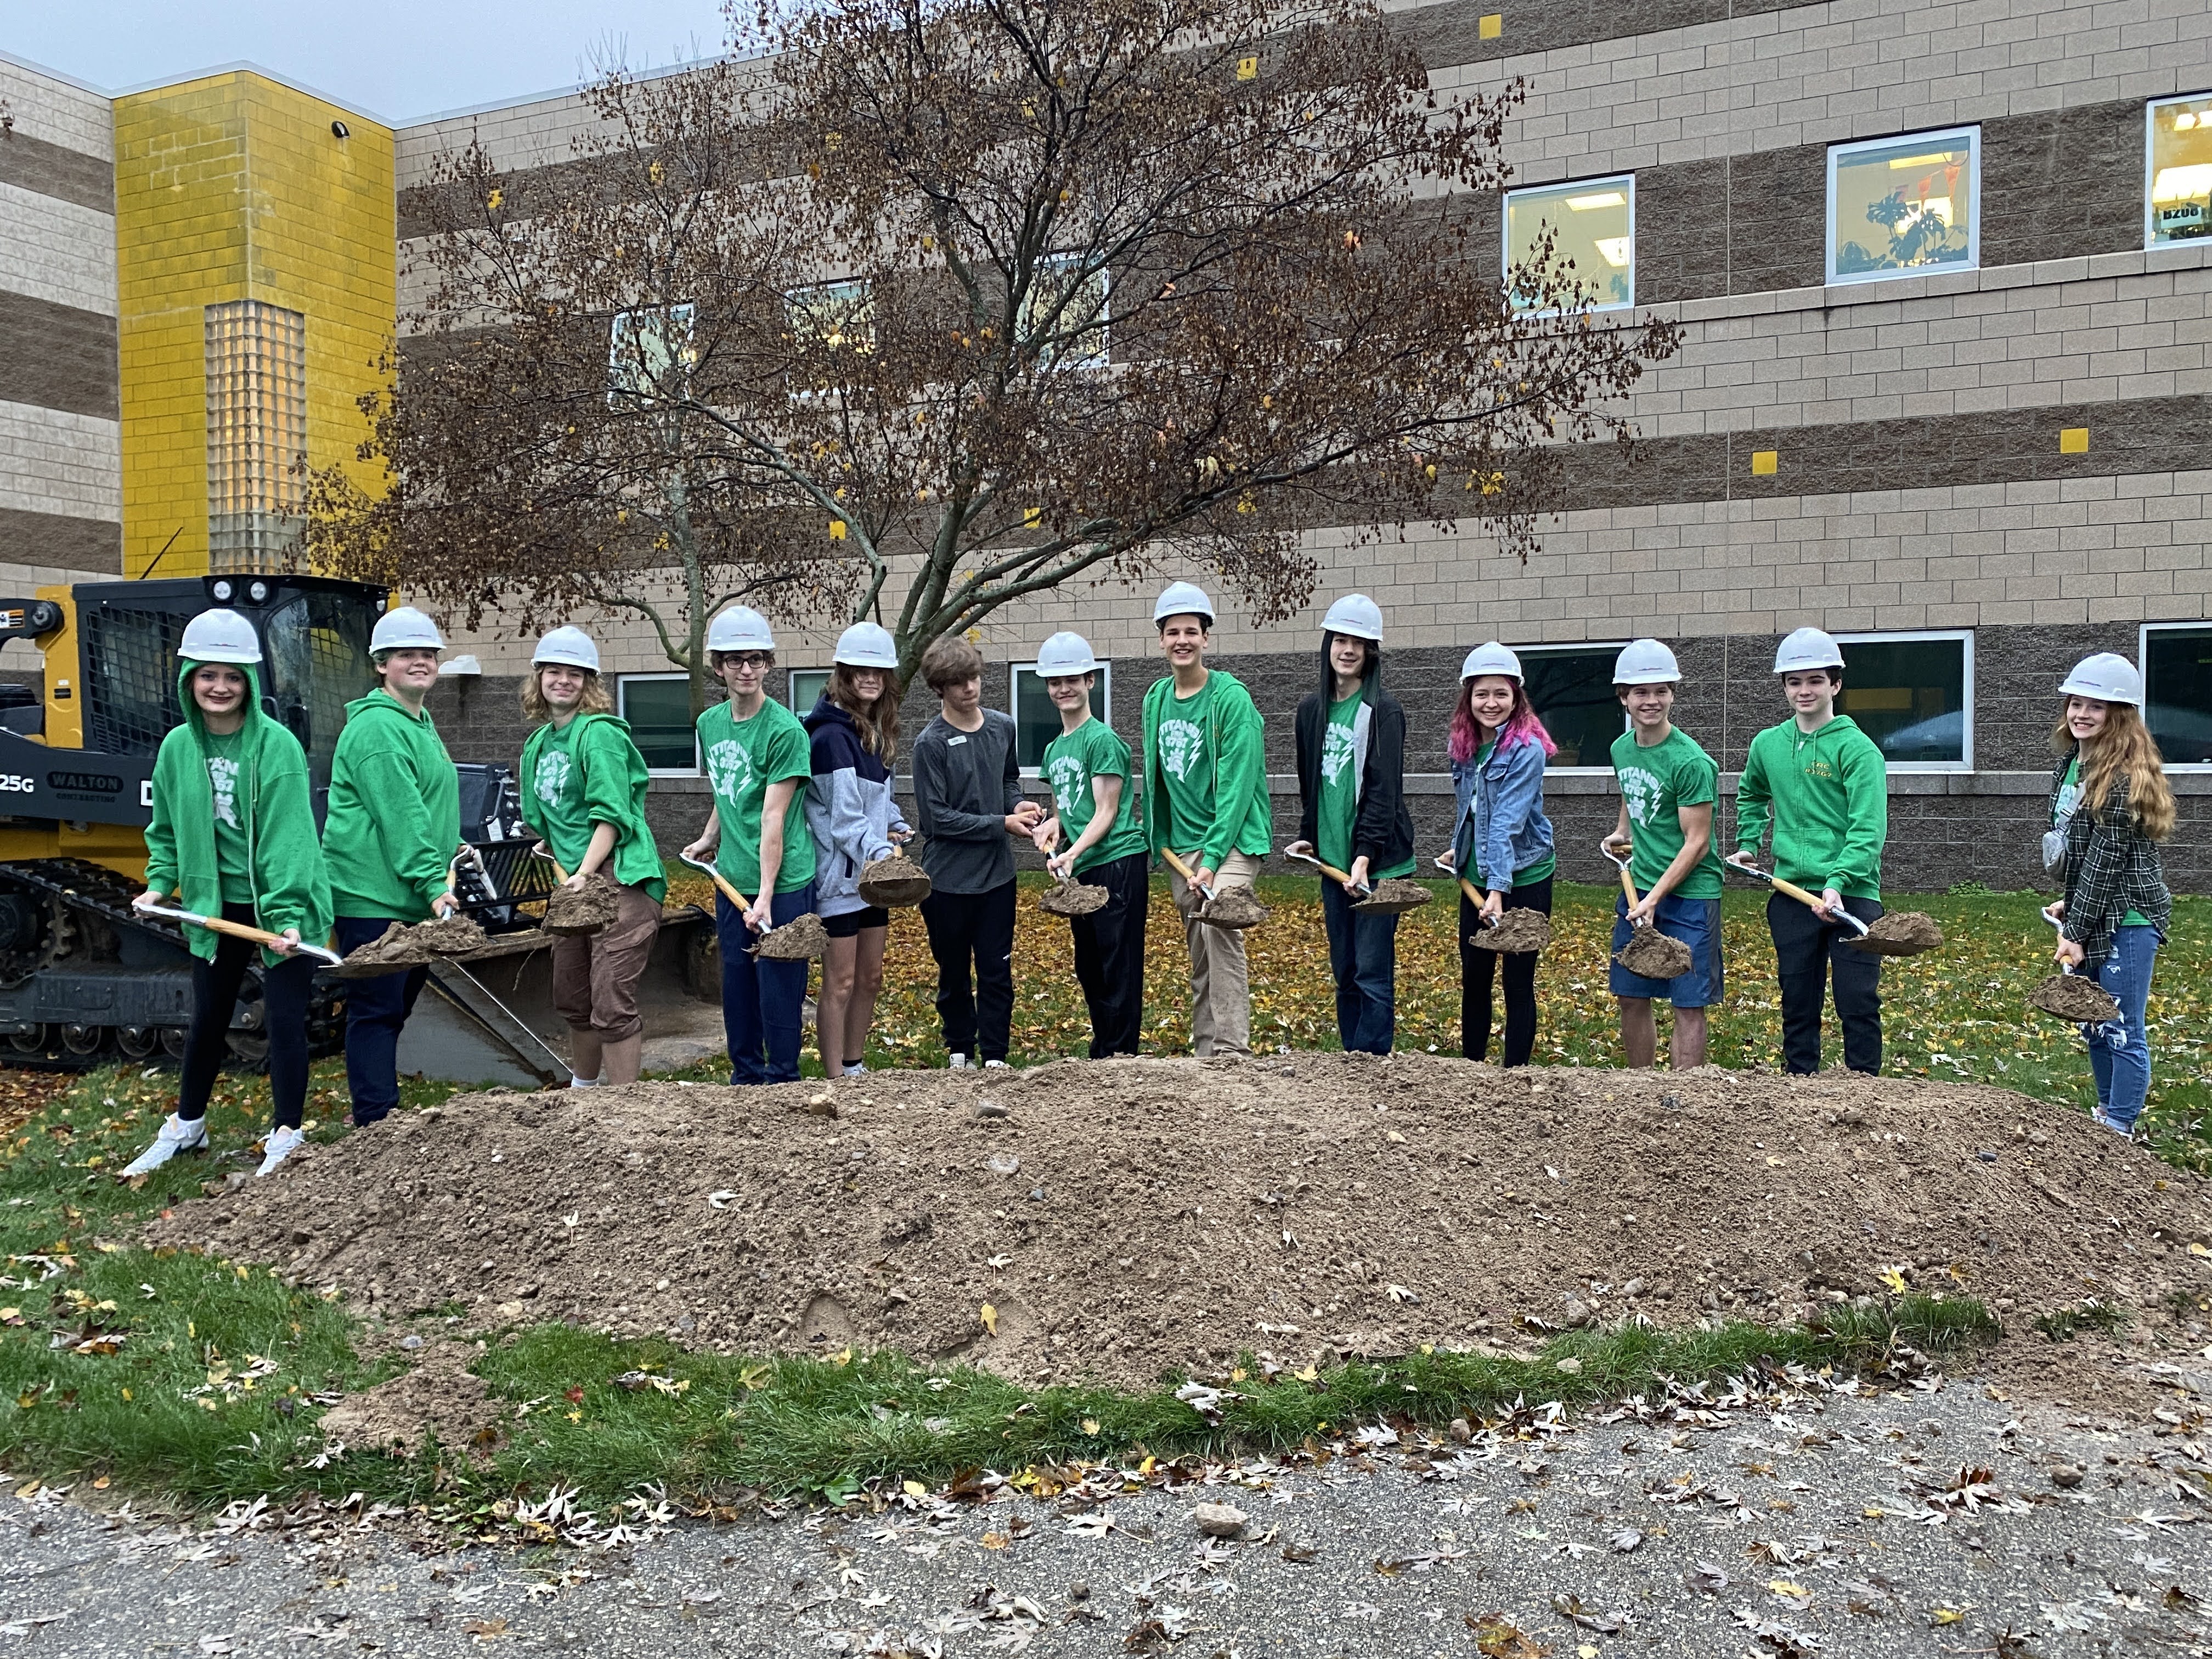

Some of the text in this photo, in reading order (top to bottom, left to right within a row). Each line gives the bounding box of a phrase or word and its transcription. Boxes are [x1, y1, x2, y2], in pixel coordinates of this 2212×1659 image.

[1159, 719, 1200, 739] TITANS
[52, 774, 118, 790] WALTON
[1618, 766, 1660, 791] TITANS
